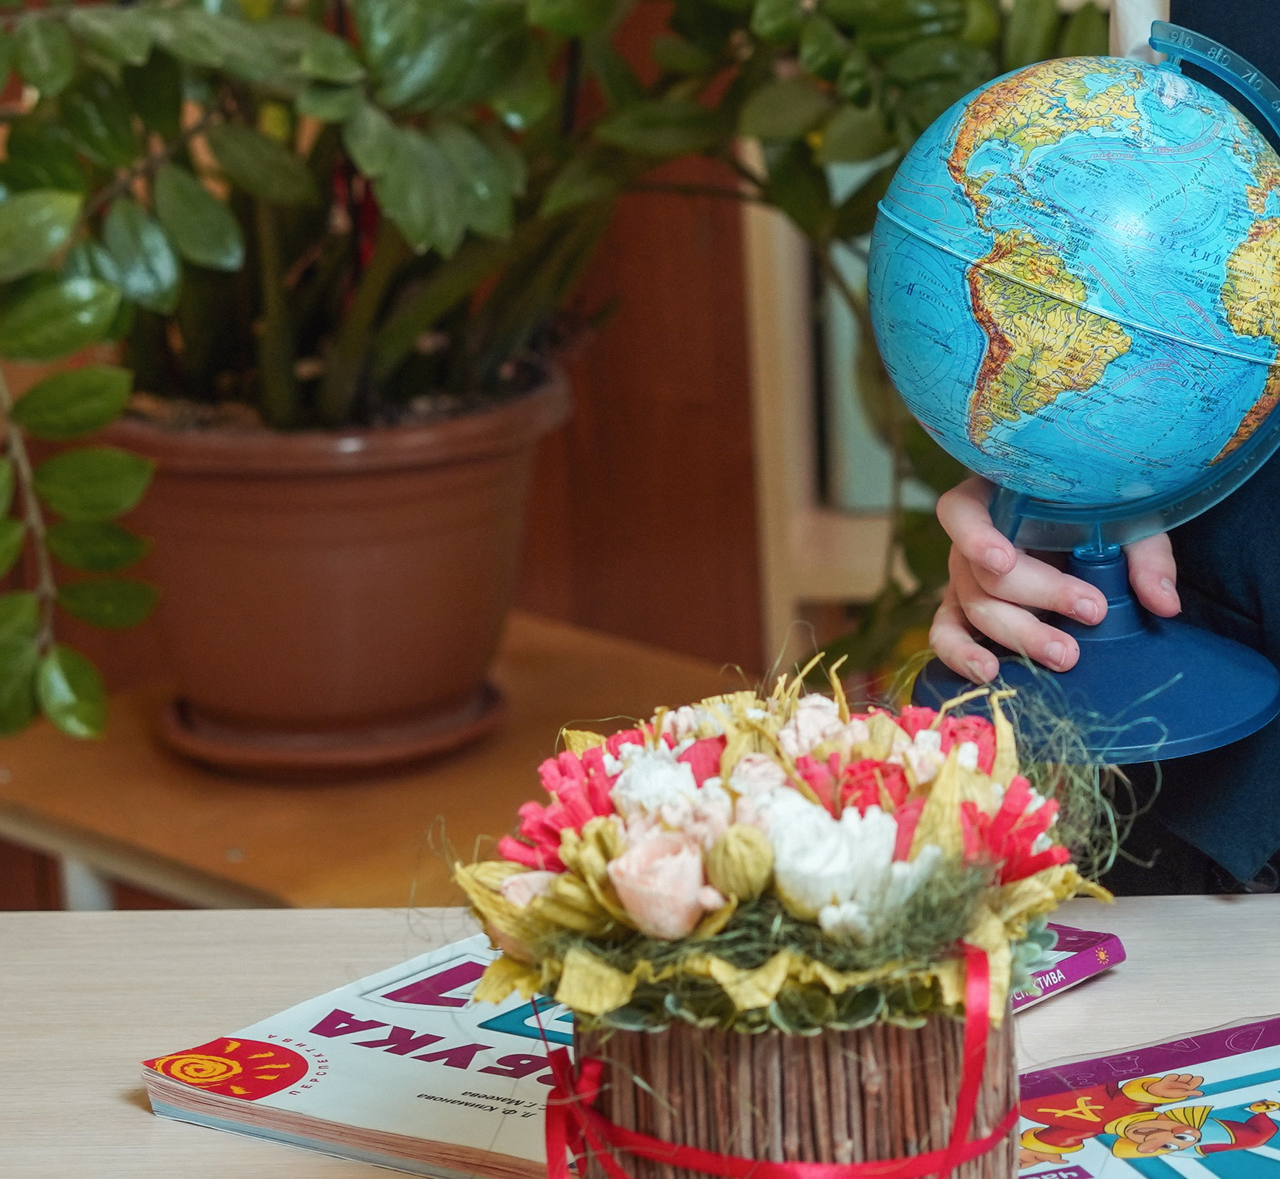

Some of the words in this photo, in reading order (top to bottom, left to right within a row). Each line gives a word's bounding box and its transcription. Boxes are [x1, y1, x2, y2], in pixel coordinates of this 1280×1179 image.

[267, 1033, 330, 1097] ПЕРСПЕКТИВА
[416, 1093, 499, 1113] Климанова
[460, 1090, 525, 1107] Макеева
